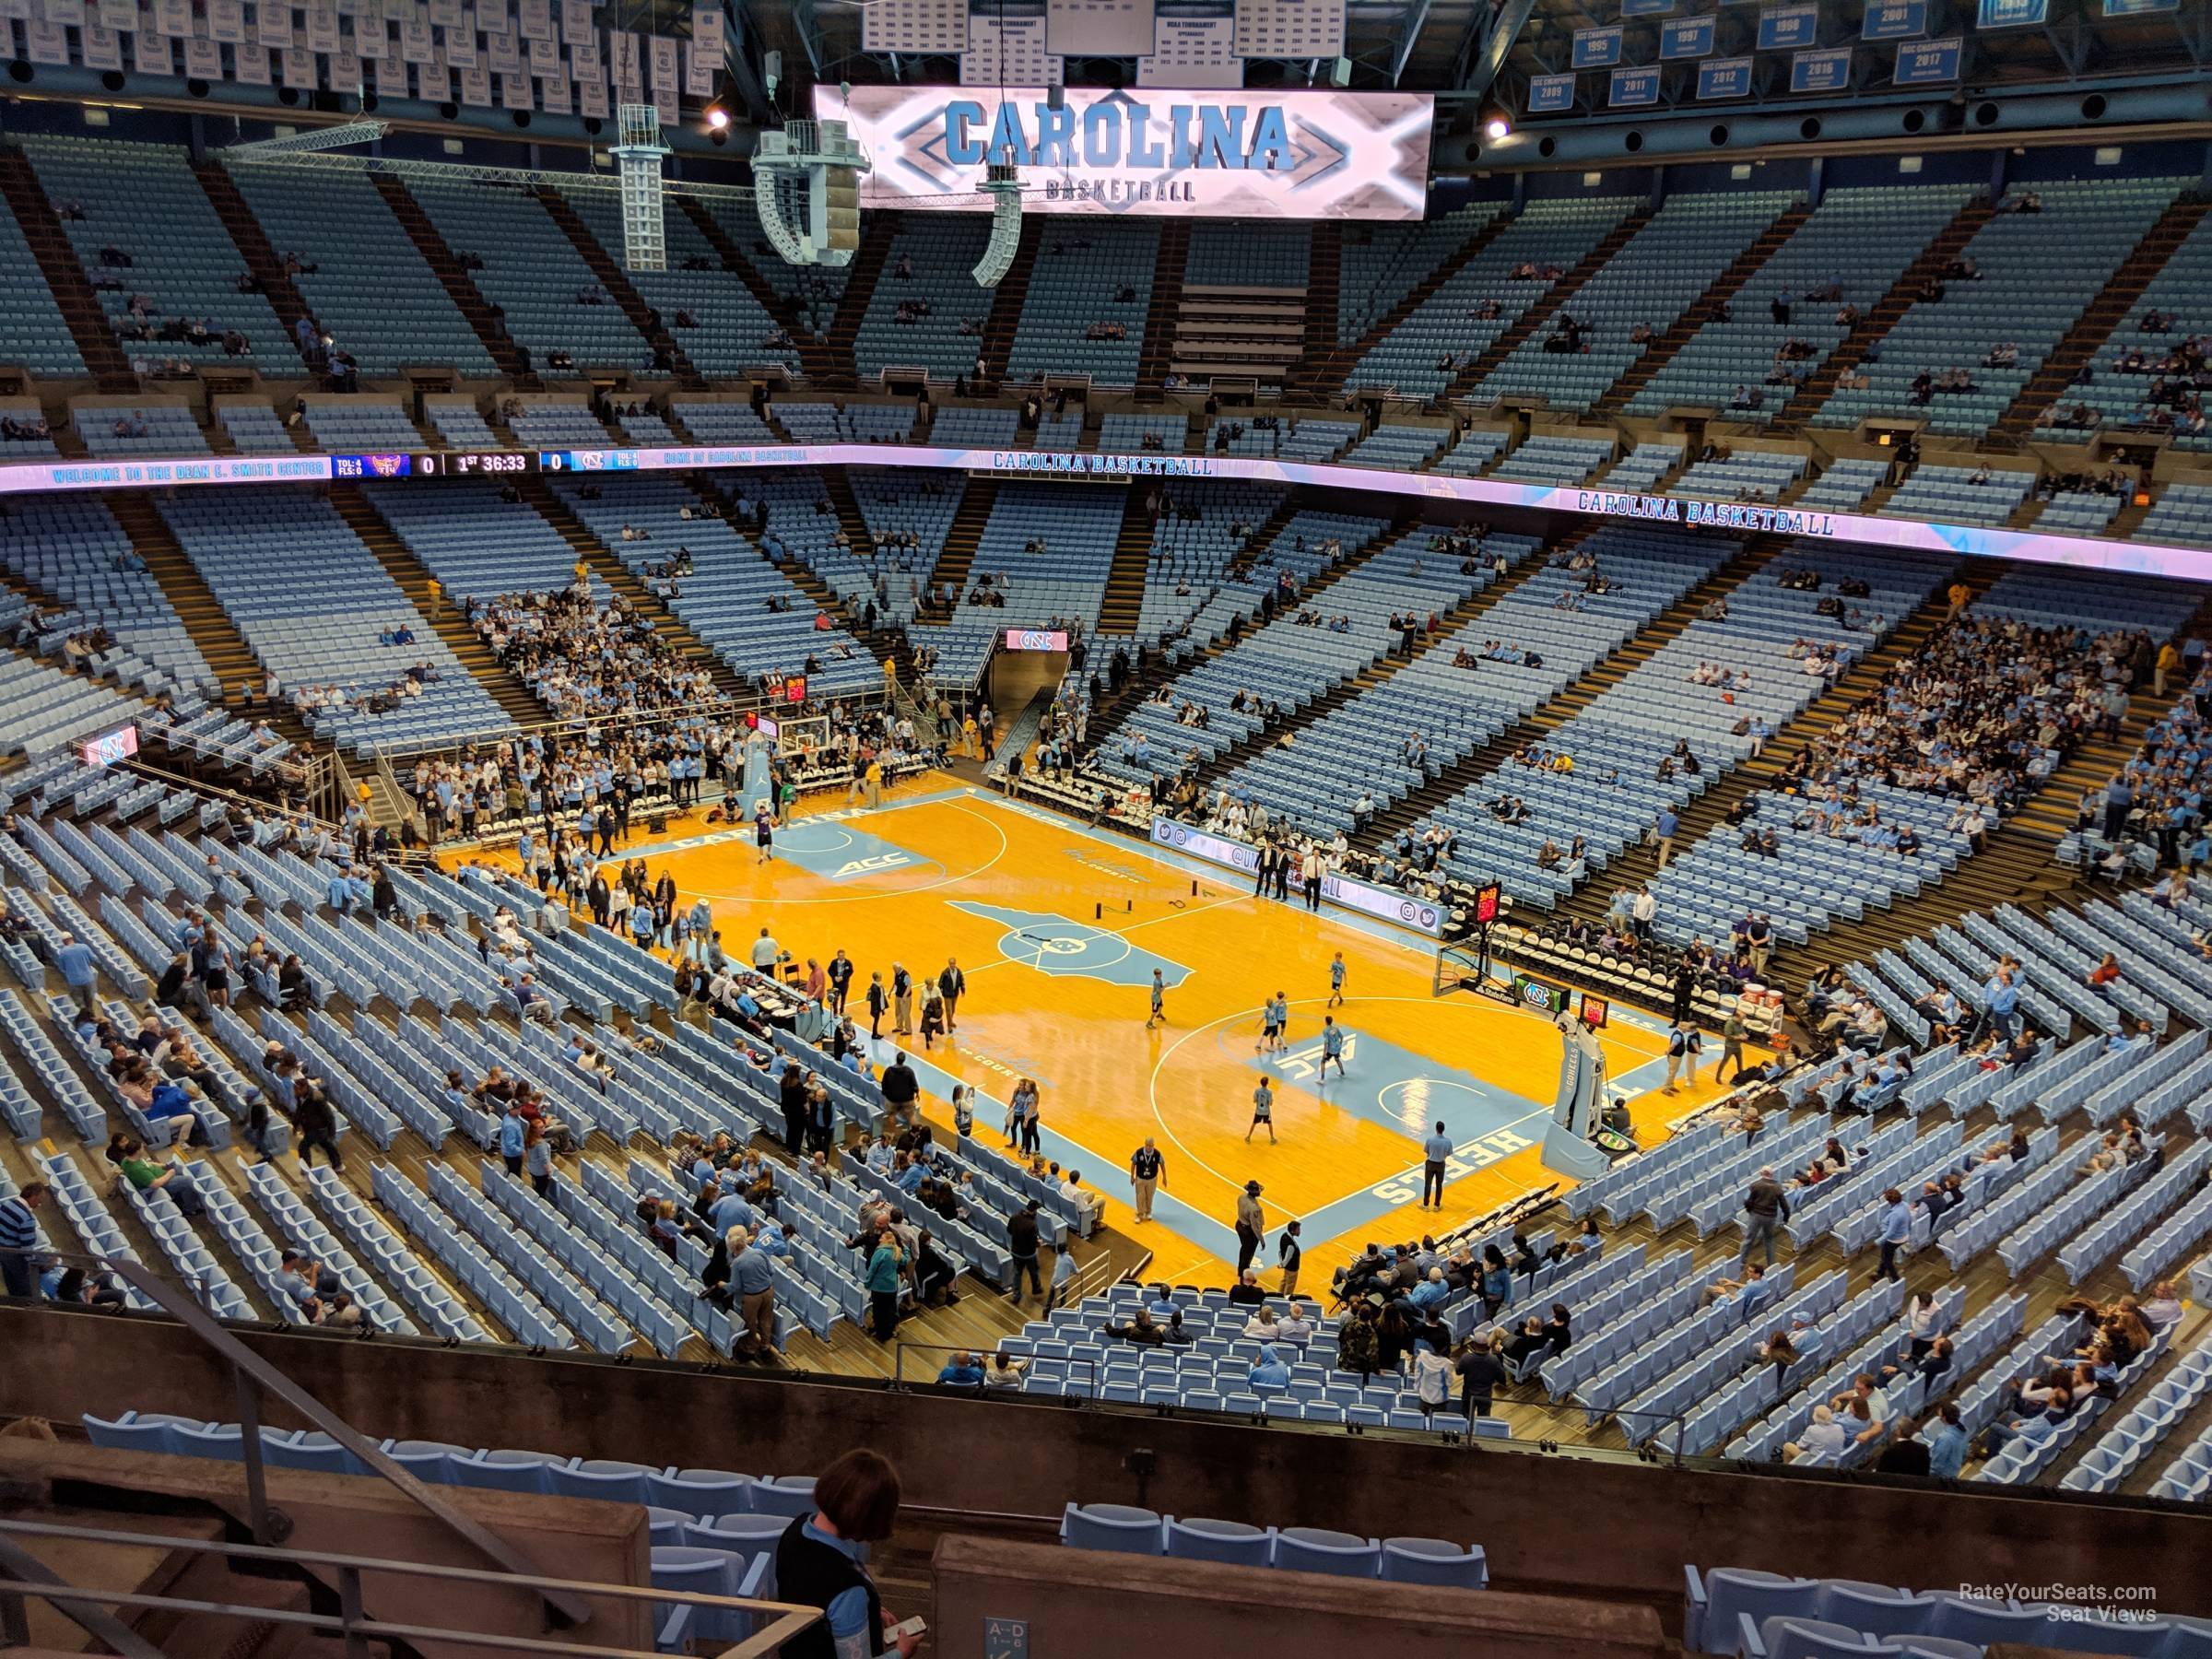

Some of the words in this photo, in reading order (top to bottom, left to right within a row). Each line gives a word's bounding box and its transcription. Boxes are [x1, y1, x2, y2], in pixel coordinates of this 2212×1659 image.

[1915, 53, 1941, 66] 2017
[1625, 80, 1645, 91] 2011
[1712, 71, 1735, 84] 2012
[1541, 87, 1561, 98] 2009
[946, 100, 1294, 170] CAROLINA
[1047, 179, 1196, 202] BASKETBALL
[337, 459, 355, 467] TOL:
[356, 459, 361, 467] 4
[483, 455, 525, 471] 36:33
[551, 453, 561, 469] 0
[665, 452, 691, 464] HOME
[693, 452, 704, 463] OF
[708, 450, 752, 464] CAROLINA
[755, 450, 808, 463] BASKETBALL
[994, 453, 1086, 472] CAROLINA
[1092, 455, 1212, 476] BASKETBALL
[53, 466, 122, 483] WELCOME
[125, 467, 142, 480] TO
[147, 466, 171, 480] THE
[176, 465, 210, 479] DEAN
[214, 464, 228, 478] E.
[232, 463, 273, 477] SMITH
[277, 461, 324, 476] CENTER
[338, 467, 356, 476] FLS:
[423, 457, 434, 474] 0
[1579, 491, 1679, 522] CAROLINA
[1687, 501, 1834, 535] BASKETBALL
[672, 807, 873, 850] CARLINA
[831, 852, 910, 877] ACC
[1088, 864, 1127, 878] COURT
